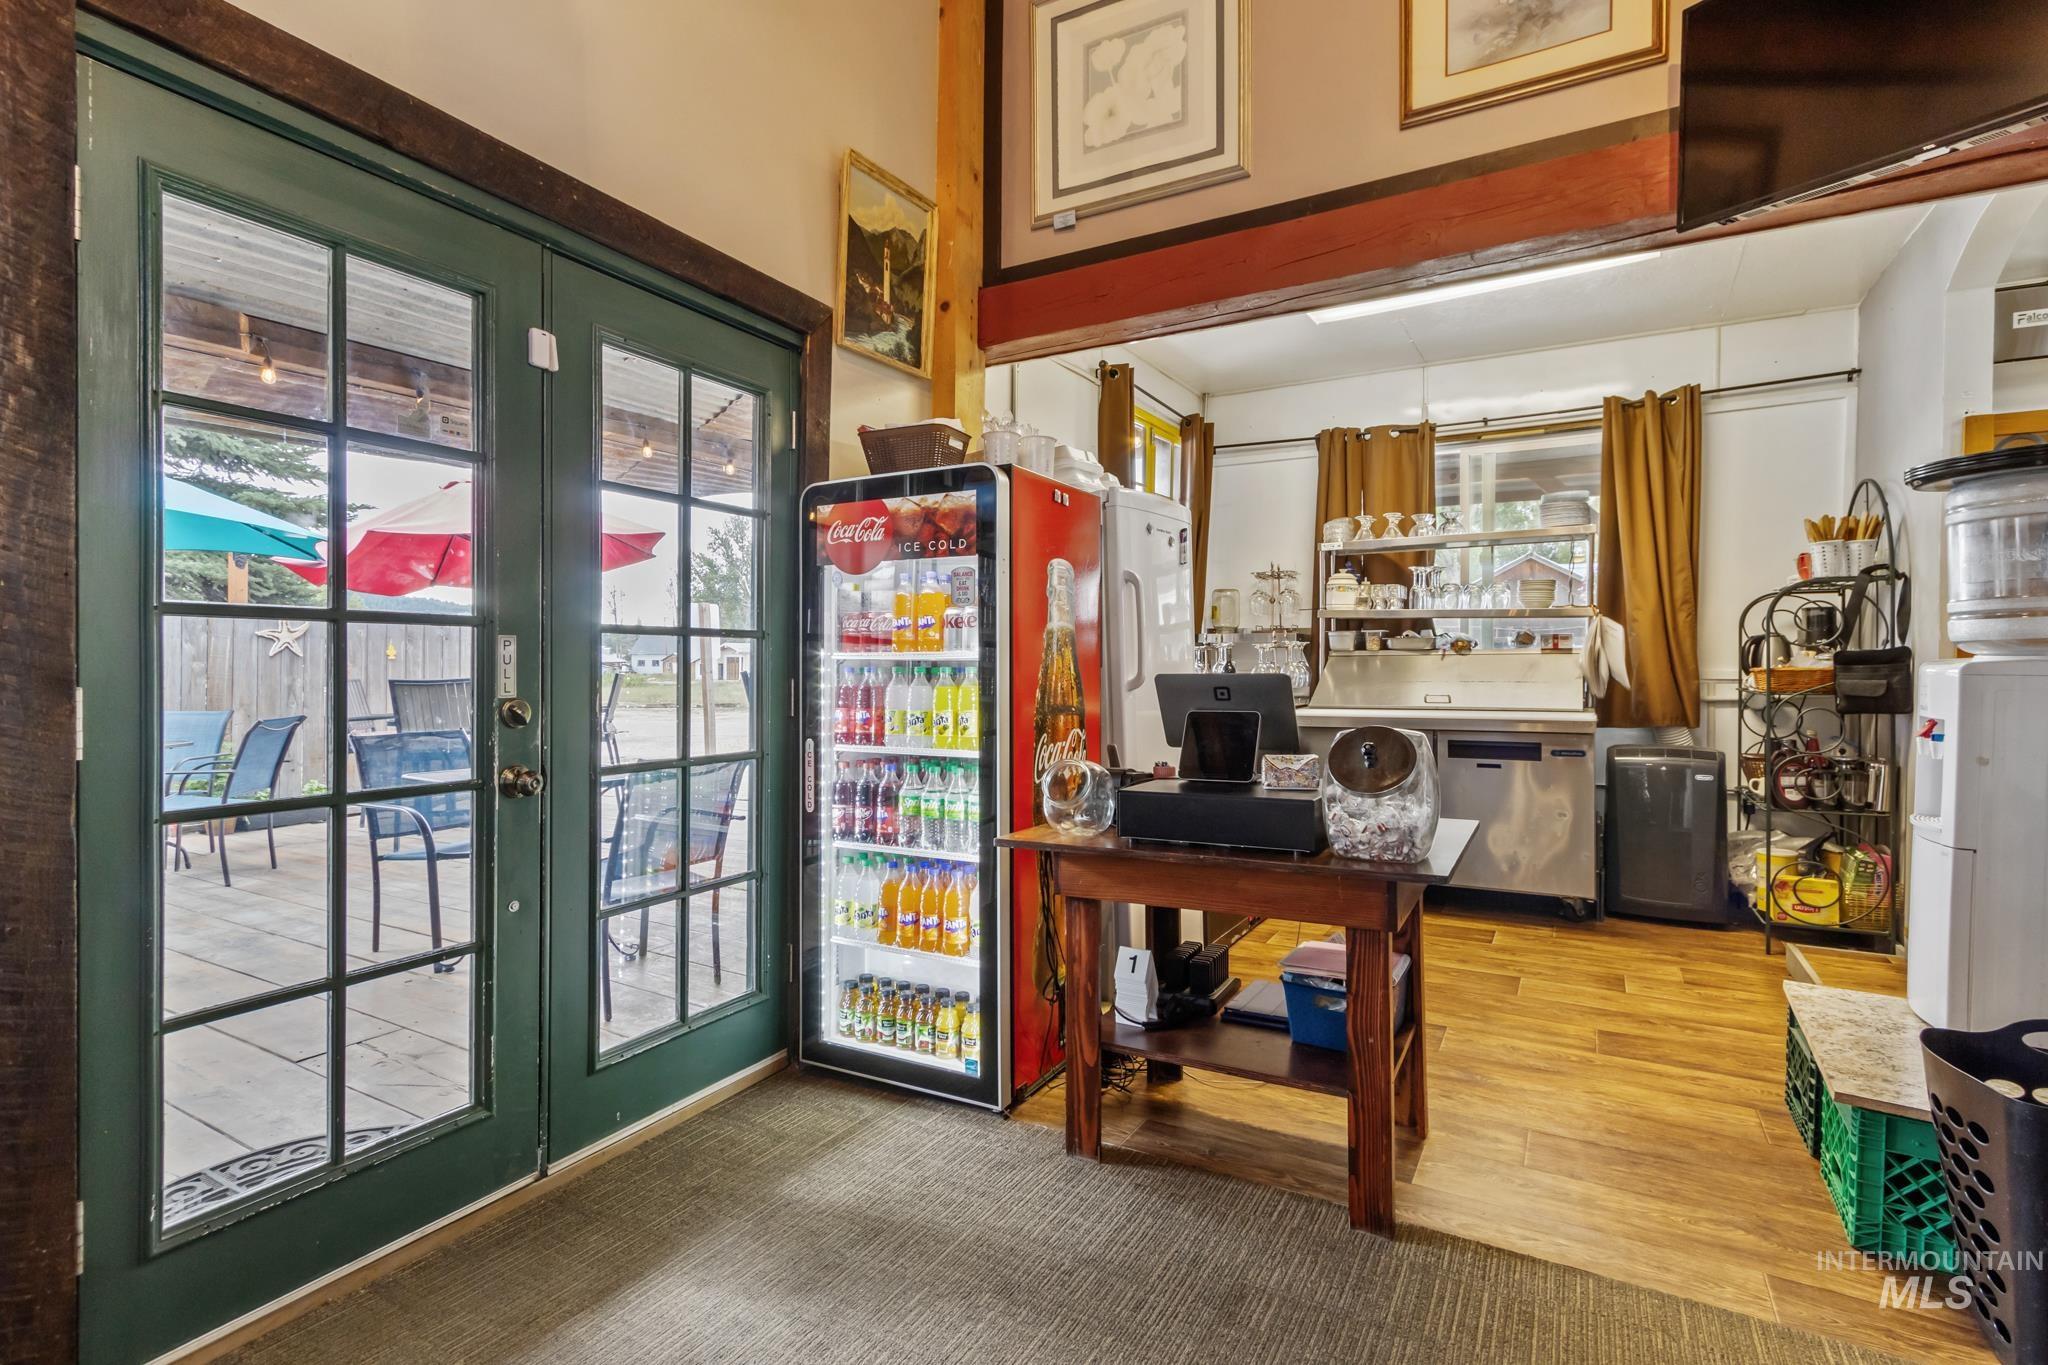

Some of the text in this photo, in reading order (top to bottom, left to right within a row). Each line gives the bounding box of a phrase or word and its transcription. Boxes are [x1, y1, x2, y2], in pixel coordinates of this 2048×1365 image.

[827, 516, 888, 544] Coca-Cola
[898, 538, 967, 553] ICE COLD
[503, 640, 512, 693] PULL
[1129, 955, 1137, 973] 1
